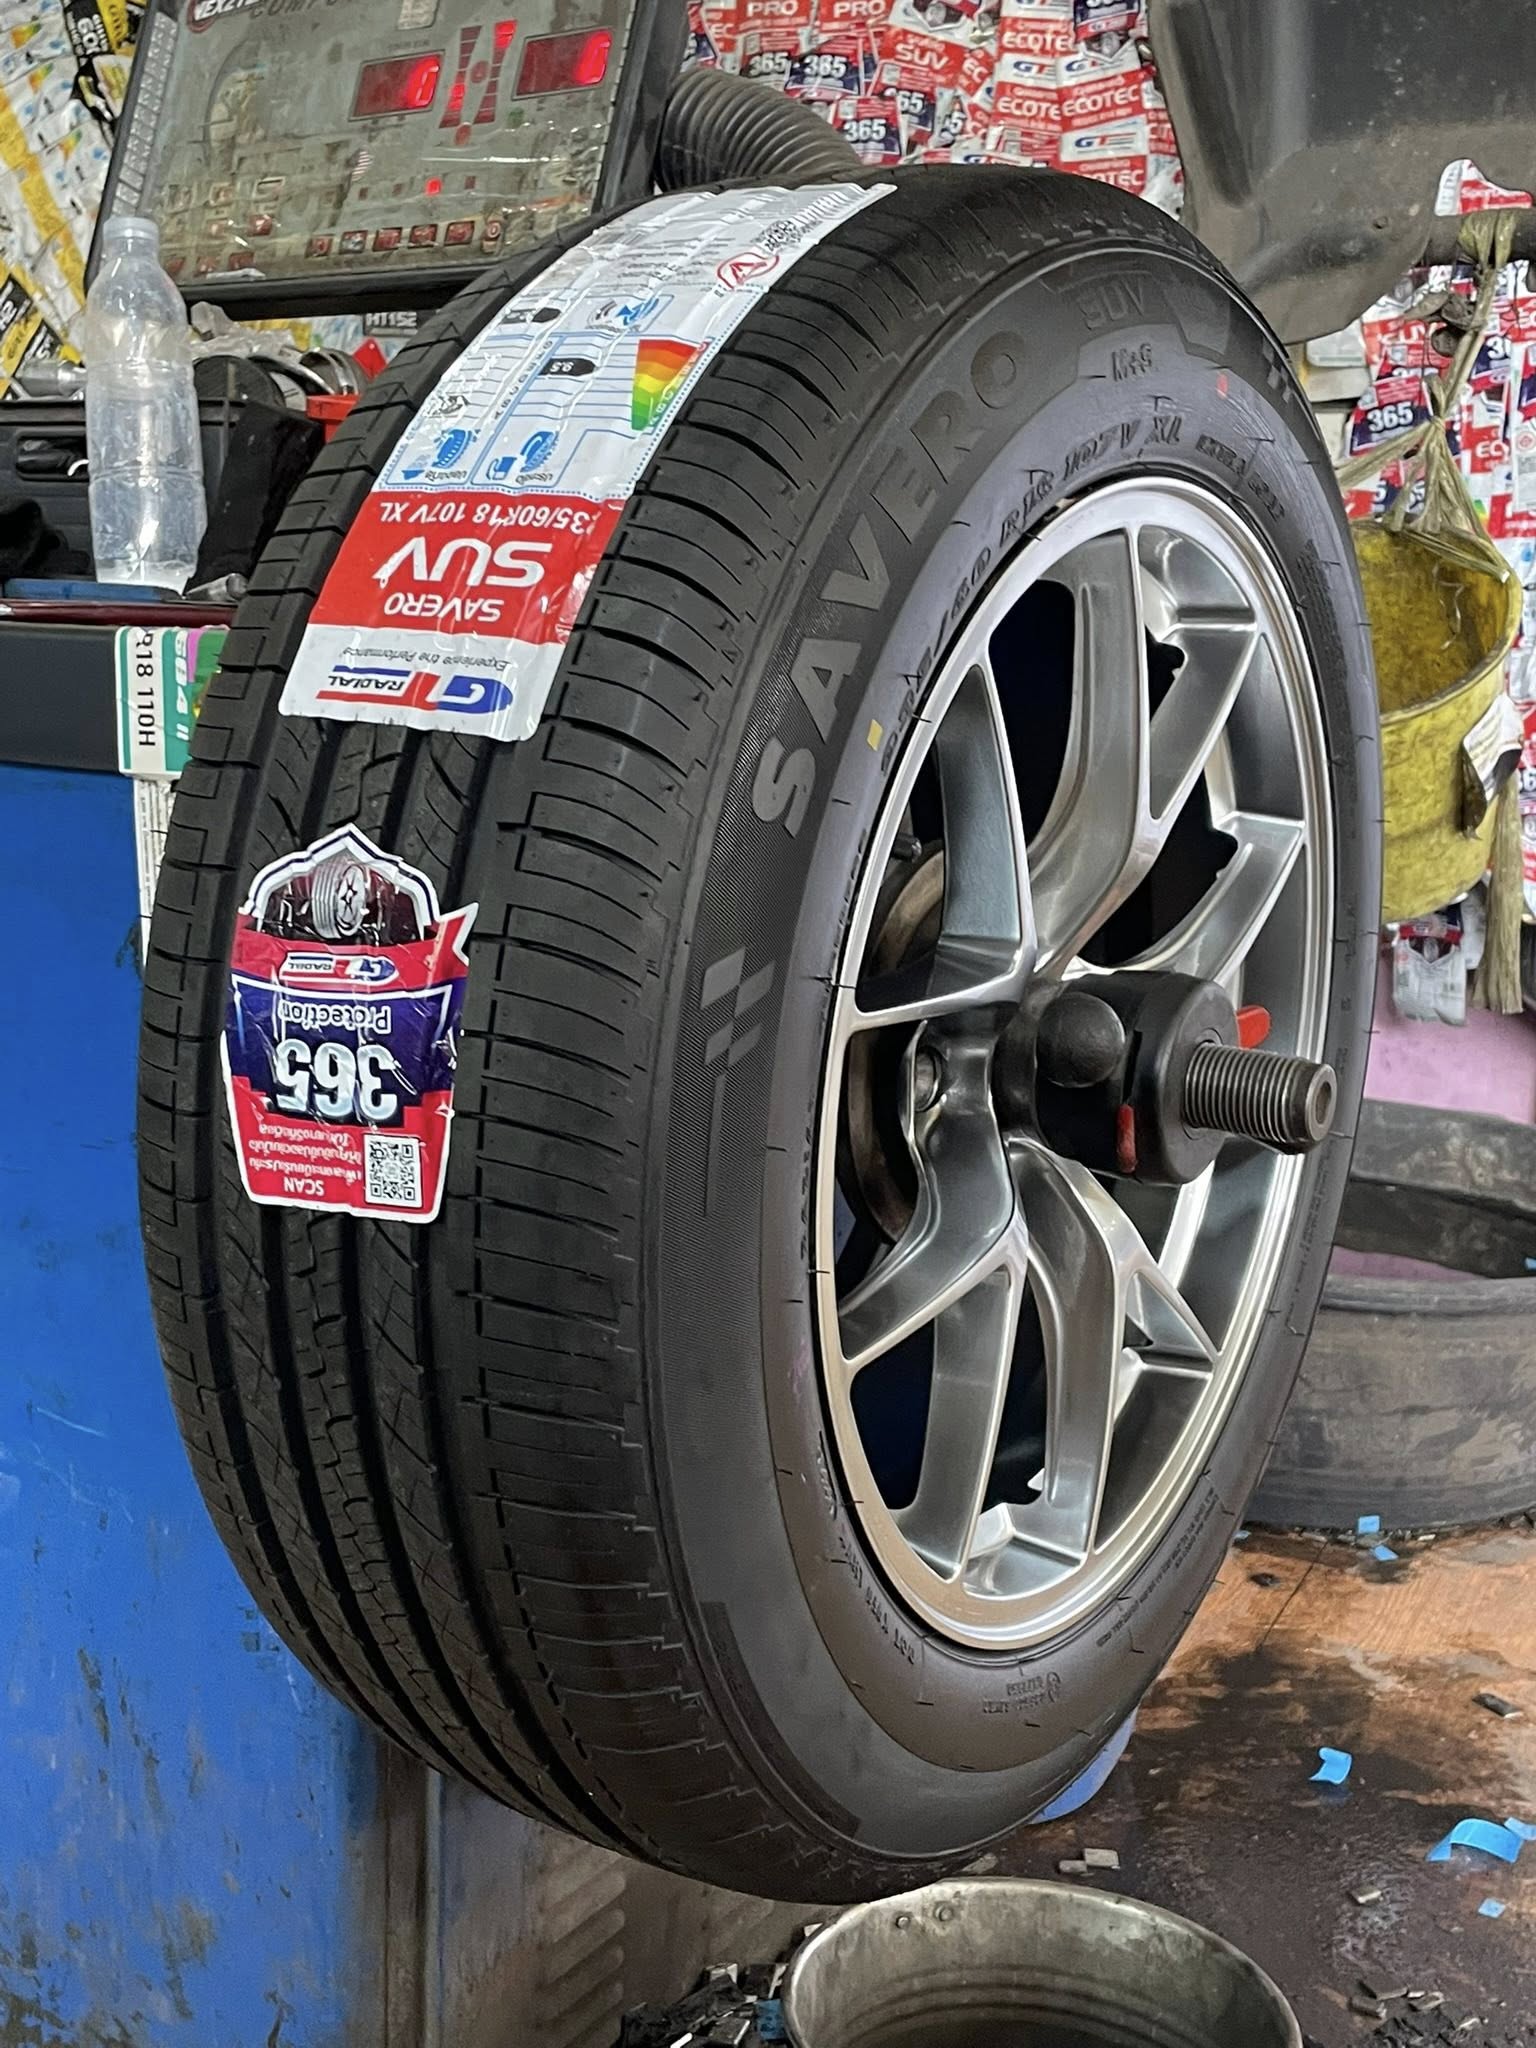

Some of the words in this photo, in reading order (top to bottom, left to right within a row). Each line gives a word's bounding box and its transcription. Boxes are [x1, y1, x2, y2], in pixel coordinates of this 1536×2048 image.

[746, 0, 799, 16] PRO
[833, 0, 886, 18] PRO
[750, 52, 788, 76] 365
[895, 43, 949, 70] SUV
[1063, 84, 1140, 117] ECOTEC
[844, 119, 887, 142] 365
[1367, 402, 1414, 432] 365
[379, 501, 410, 522] XL
[409, 501, 468, 524] 107V
[473, 502, 595, 536] 35/60R18
[371, 536, 553, 589] SUV
[752, 330, 1030, 839] SAVERO
[384, 592, 505, 623] SAVERO
[327, 674, 405, 692] RADIAL
[136, 687, 156, 747] 110H
[277, 1000, 392, 1034] Protection
[275, 1039, 399, 1121] 365
[283, 1175, 325, 1198] SCAN
